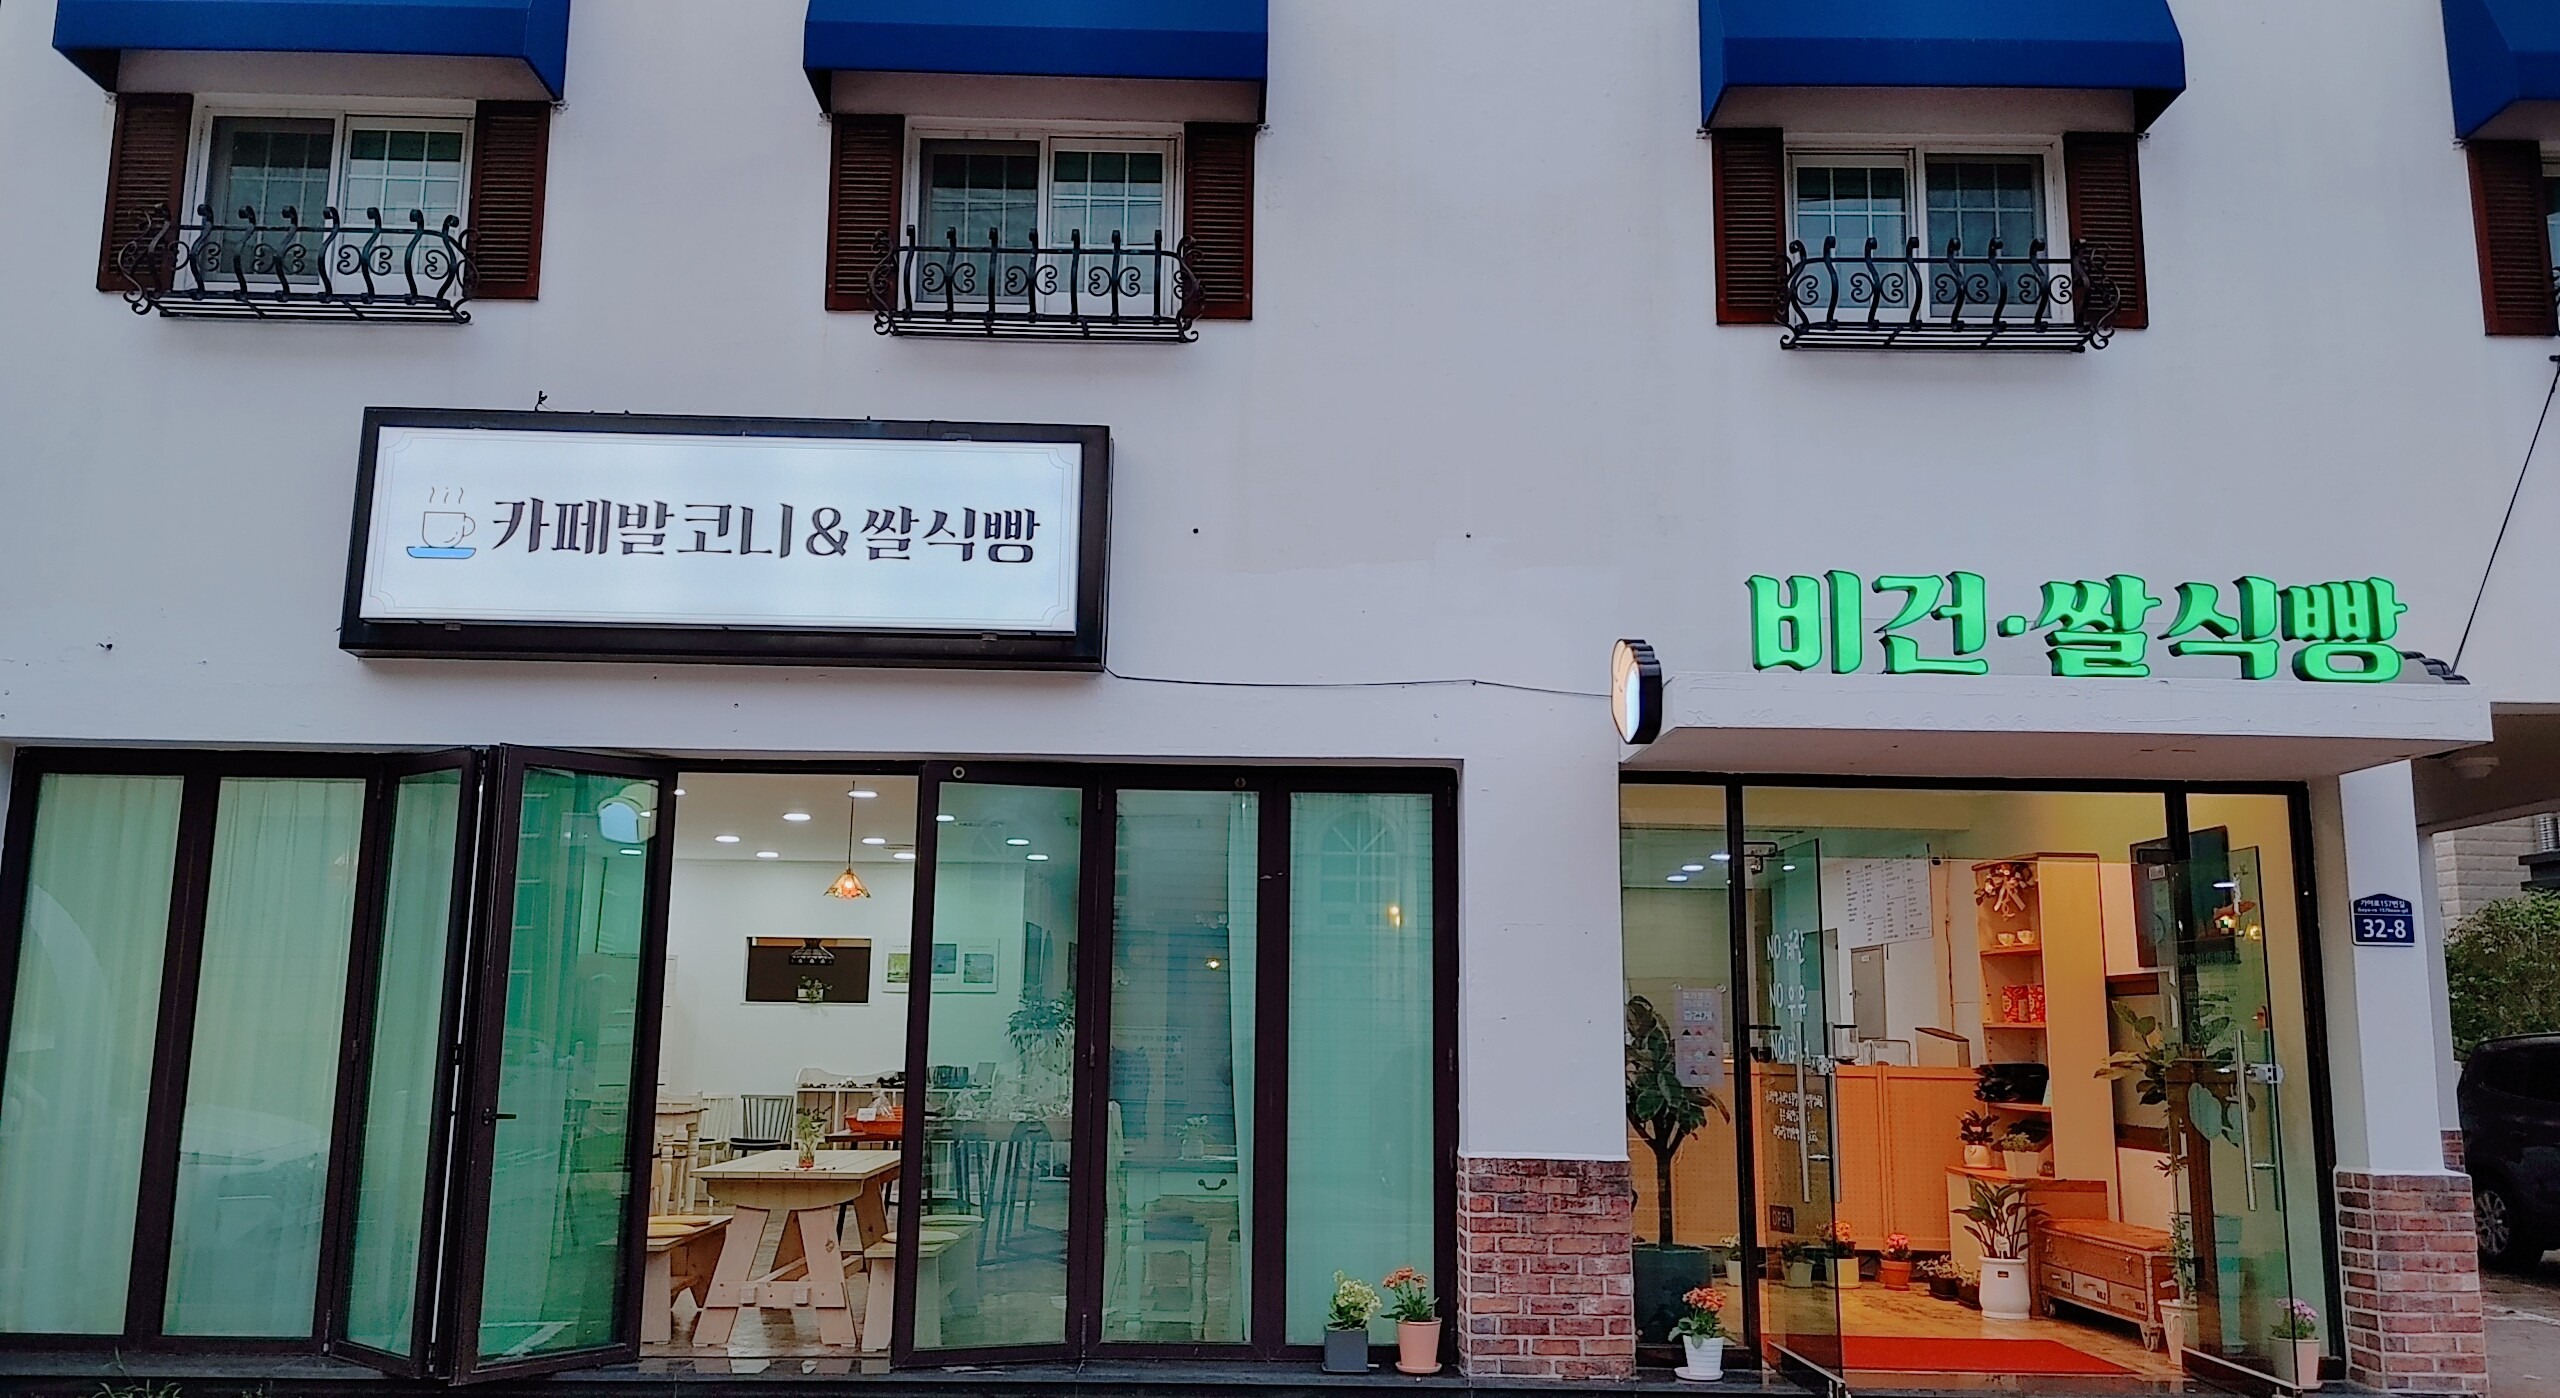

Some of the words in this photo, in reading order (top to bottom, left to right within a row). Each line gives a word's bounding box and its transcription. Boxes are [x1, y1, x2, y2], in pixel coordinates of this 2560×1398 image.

[2363, 919, 2406, 938] 32-8
[1766, 934, 1780, 960] NO
[1769, 982, 1784, 1008] NO
[1788, 985, 1807, 1018] 우유
[1770, 1035, 1786, 1060] NO
[1772, 1210, 1792, 1228] OPEN
